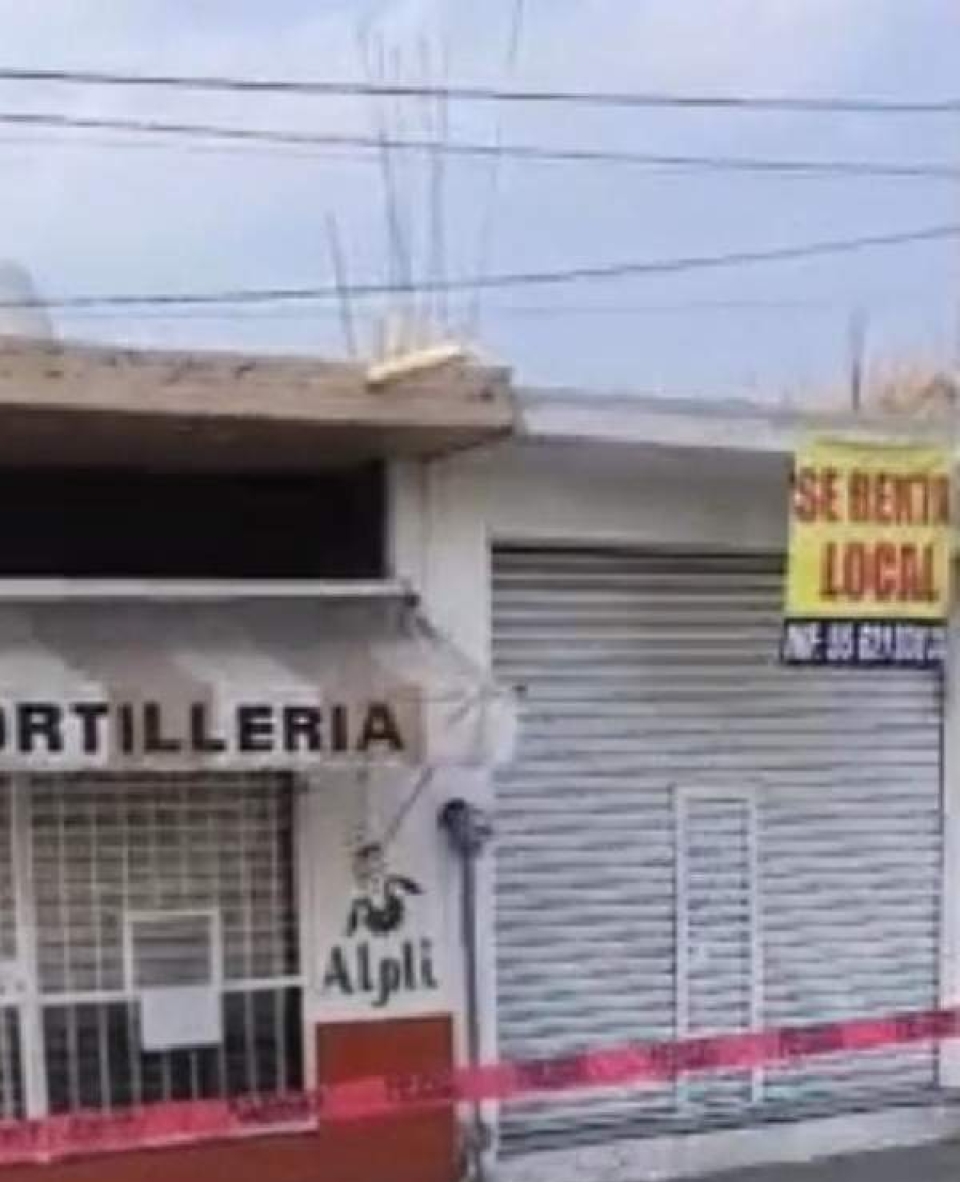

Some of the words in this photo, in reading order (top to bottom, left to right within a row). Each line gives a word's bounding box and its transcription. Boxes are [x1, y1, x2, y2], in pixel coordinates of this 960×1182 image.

[794, 466, 839, 523] SE
[819, 541, 938, 602] LOCAL
[322, 936, 439, 1008] Alpli
